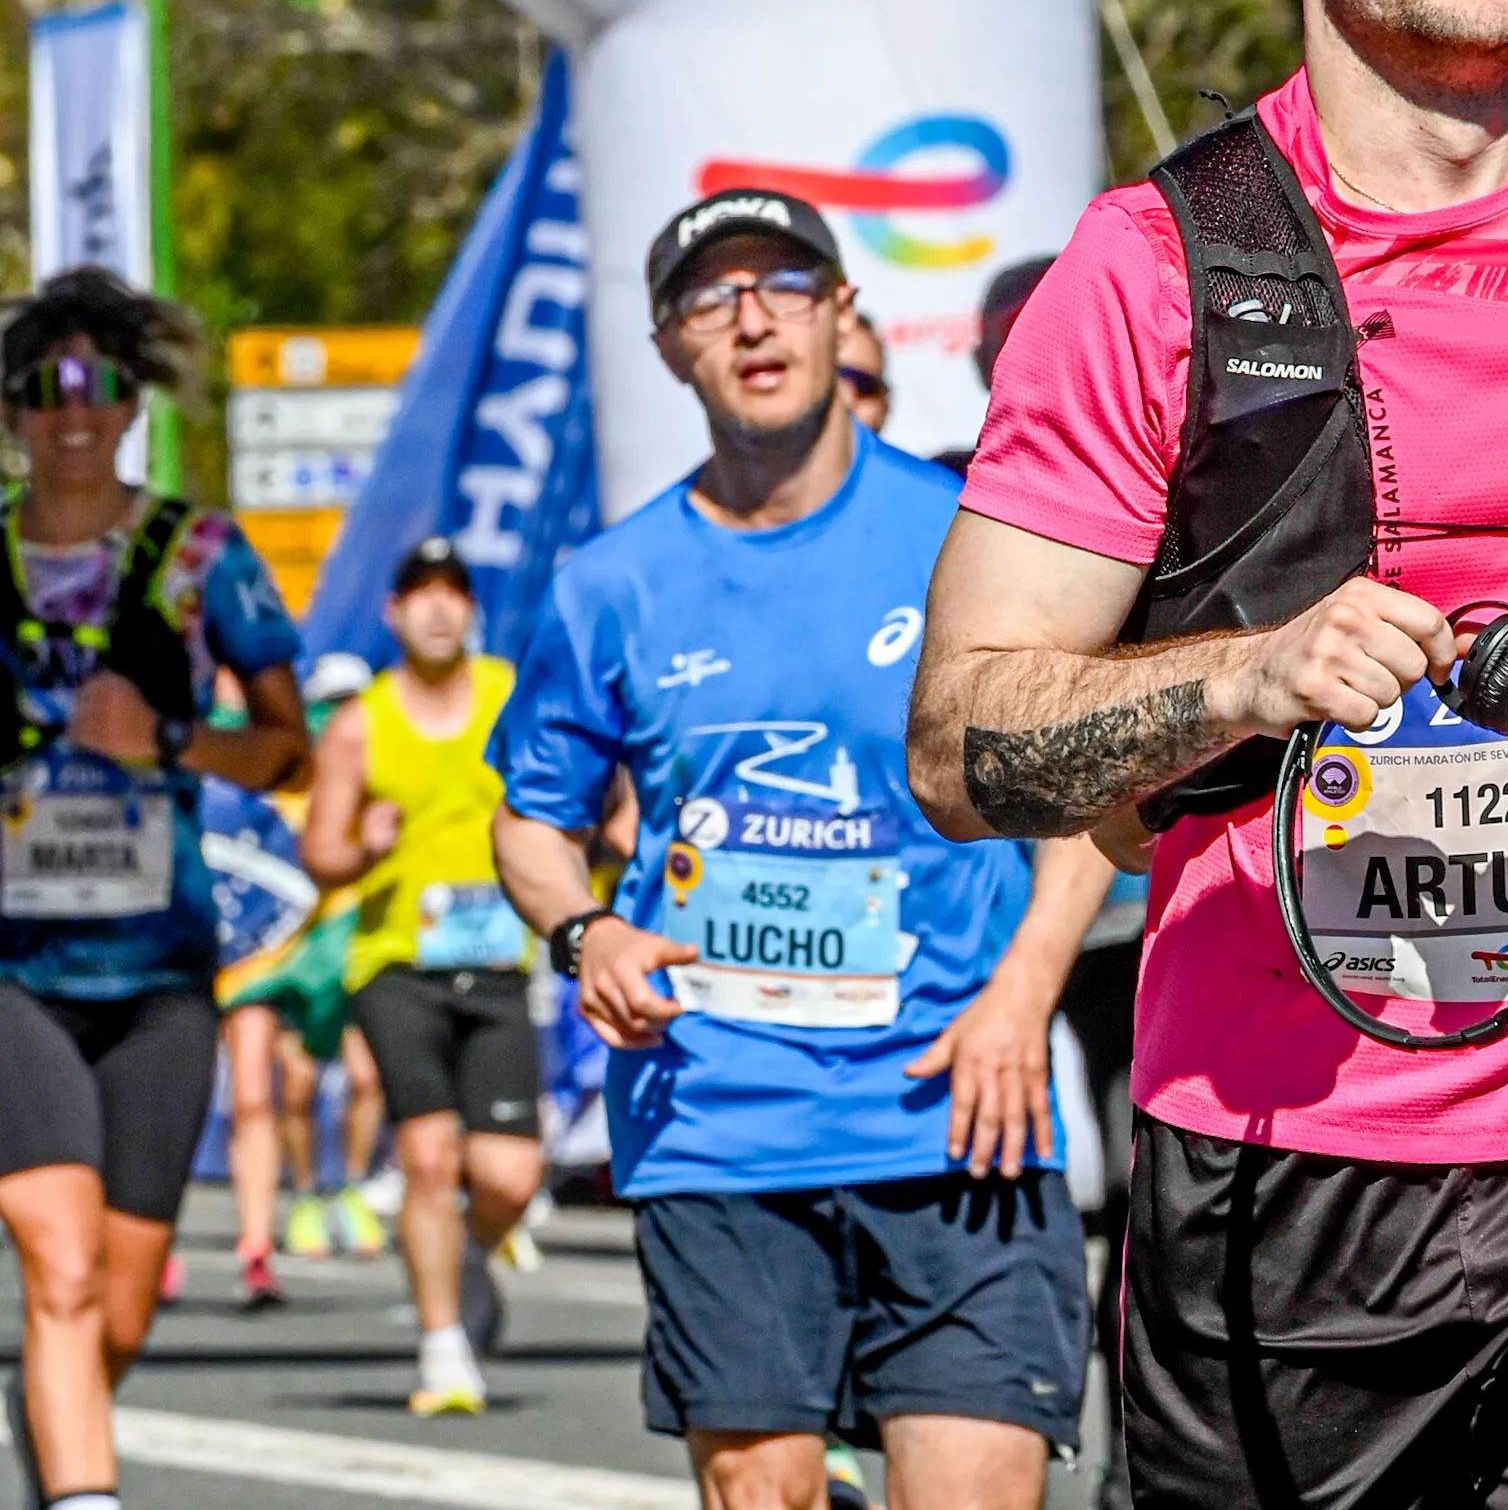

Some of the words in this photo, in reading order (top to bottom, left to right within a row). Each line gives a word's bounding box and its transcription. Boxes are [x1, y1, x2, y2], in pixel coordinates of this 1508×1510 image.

[1226, 358, 1324, 381] SALOMON
[1366, 387, 1402, 553] SALAMANCA
[1369, 755, 1412, 766] ZURICH
[1414, 752, 1472, 765] MARATÓN
[1474, 751, 1487, 762] DE
[740, 813, 872, 850] ZURICH
[741, 880, 811, 912] 4552
[705, 920, 845, 969] LUCHO
